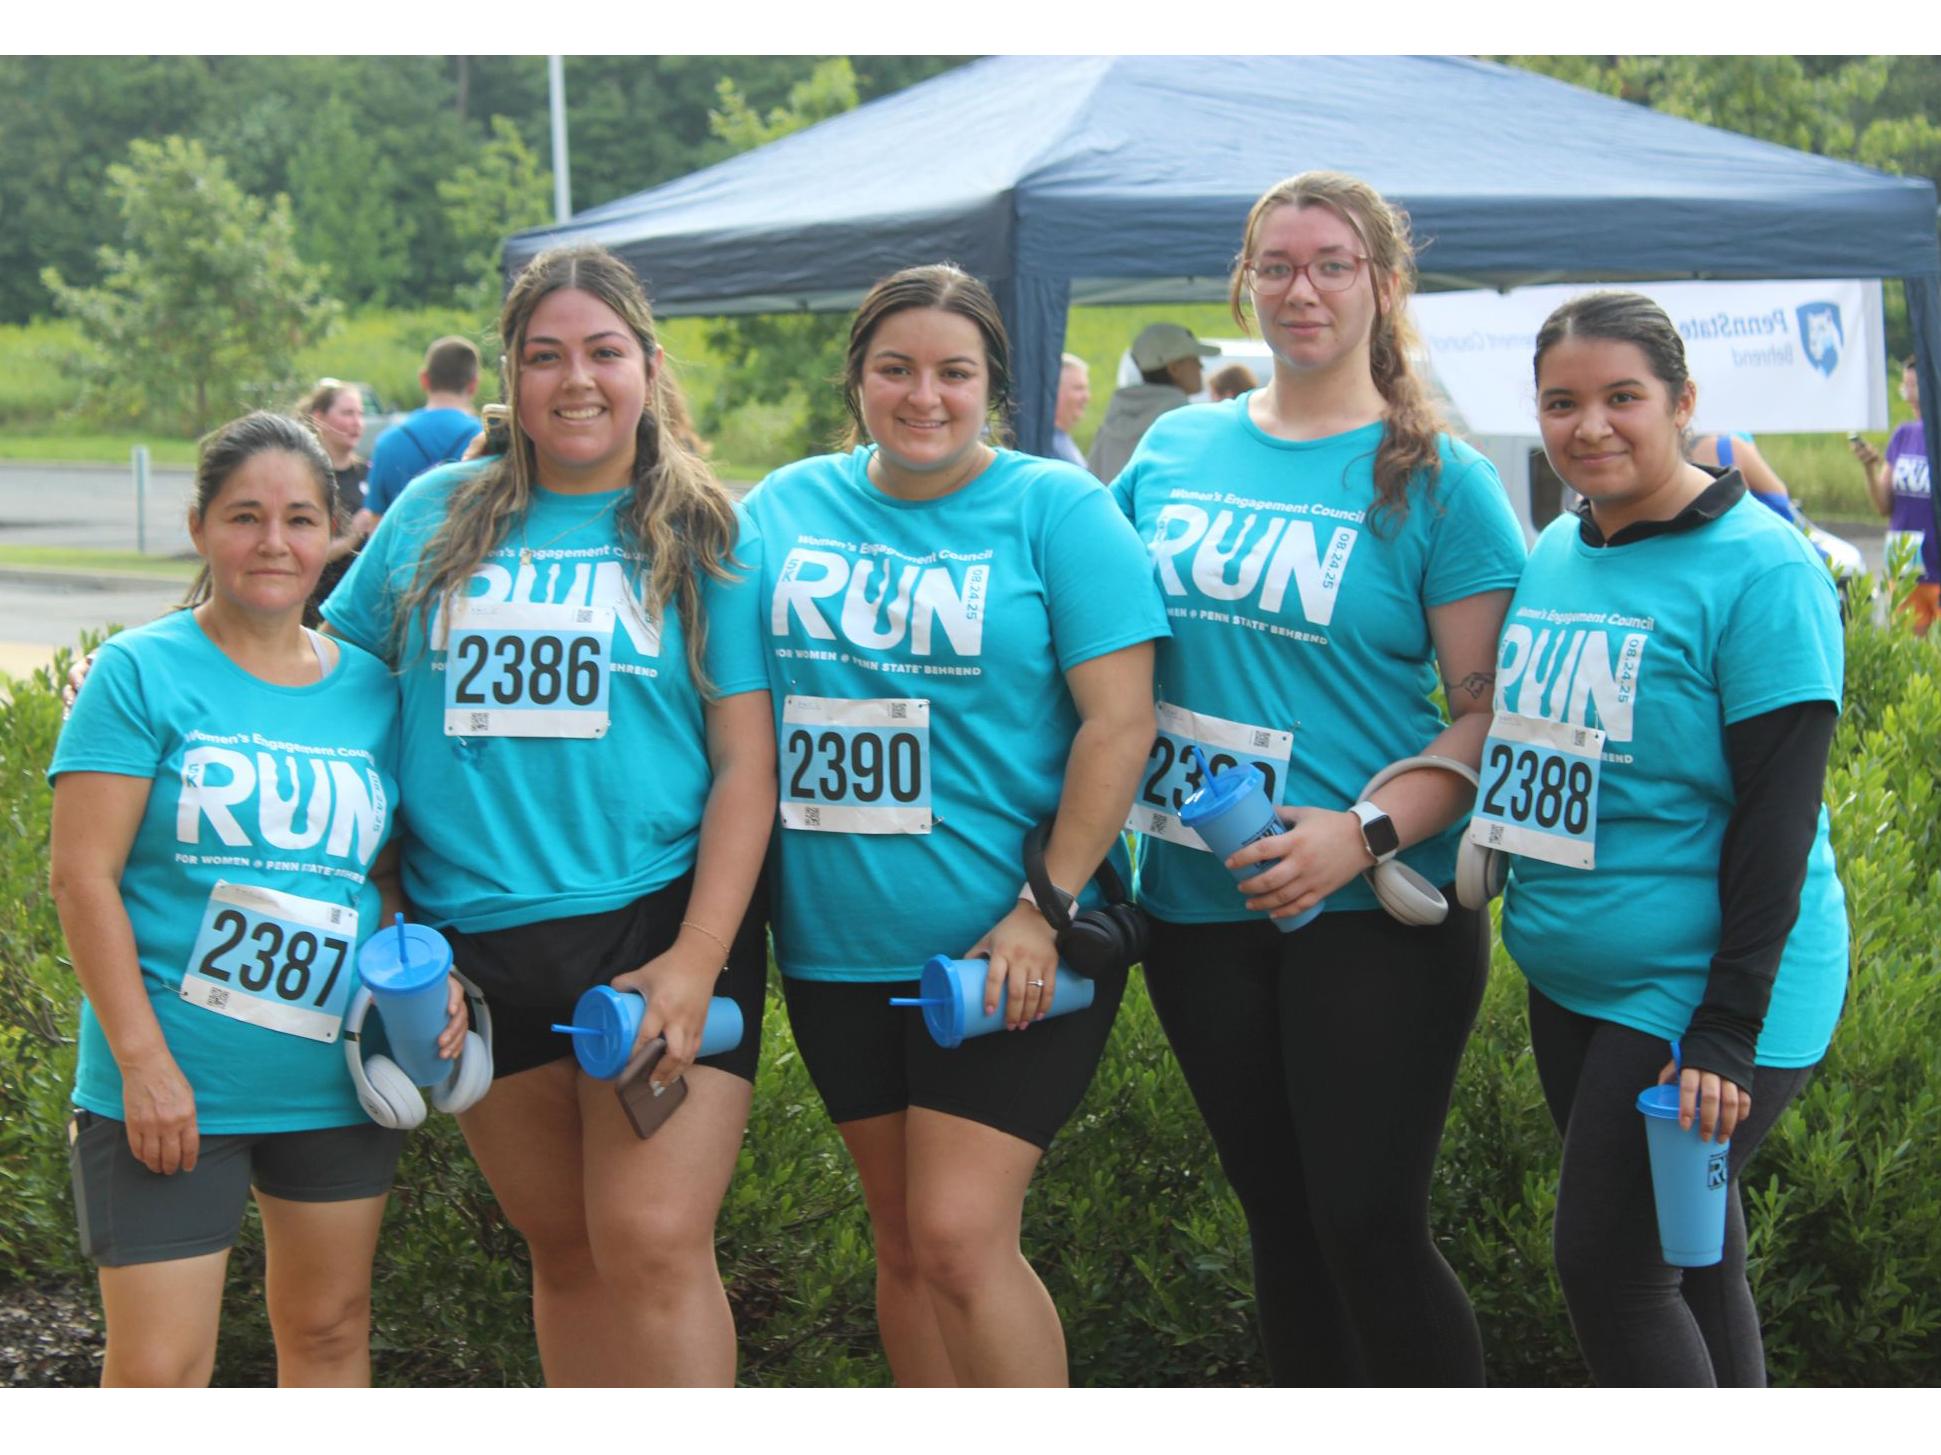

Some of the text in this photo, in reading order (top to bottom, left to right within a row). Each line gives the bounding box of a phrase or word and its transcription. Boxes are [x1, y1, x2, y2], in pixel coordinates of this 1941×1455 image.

[1893, 454, 1931, 496] RU
[1170, 488, 1365, 524] Women's Engagement Council
[798, 535, 857, 552] Women's
[939, 549, 993, 562] Council
[1147, 504, 1358, 626] RUN
[1321, 532, 1350, 590] 08.24.25
[771, 548, 990, 656] RUN
[966, 569, 983, 621] 08.24.25
[1608, 613, 1654, 631] Council
[1200, 610, 1230, 623] PENN
[1270, 626, 1329, 645] BEHREND
[455, 635, 601, 706] 2386
[609, 663, 658, 678] EHREND
[924, 666, 981, 676] BEHREND
[1617, 638, 1640, 704] 08.24.25
[184, 729, 249, 744] Women's
[252, 733, 335, 757] Engagement
[789, 729, 921, 803] 2390
[1143, 736, 1275, 811] 23
[1482, 744, 1592, 835] 2388
[176, 746, 386, 865] RUN
[175, 853, 197, 864] FOR
[201, 855, 249, 867] WOMEN
[266, 860, 299, 872] PENN
[199, 909, 348, 1008] 2387
